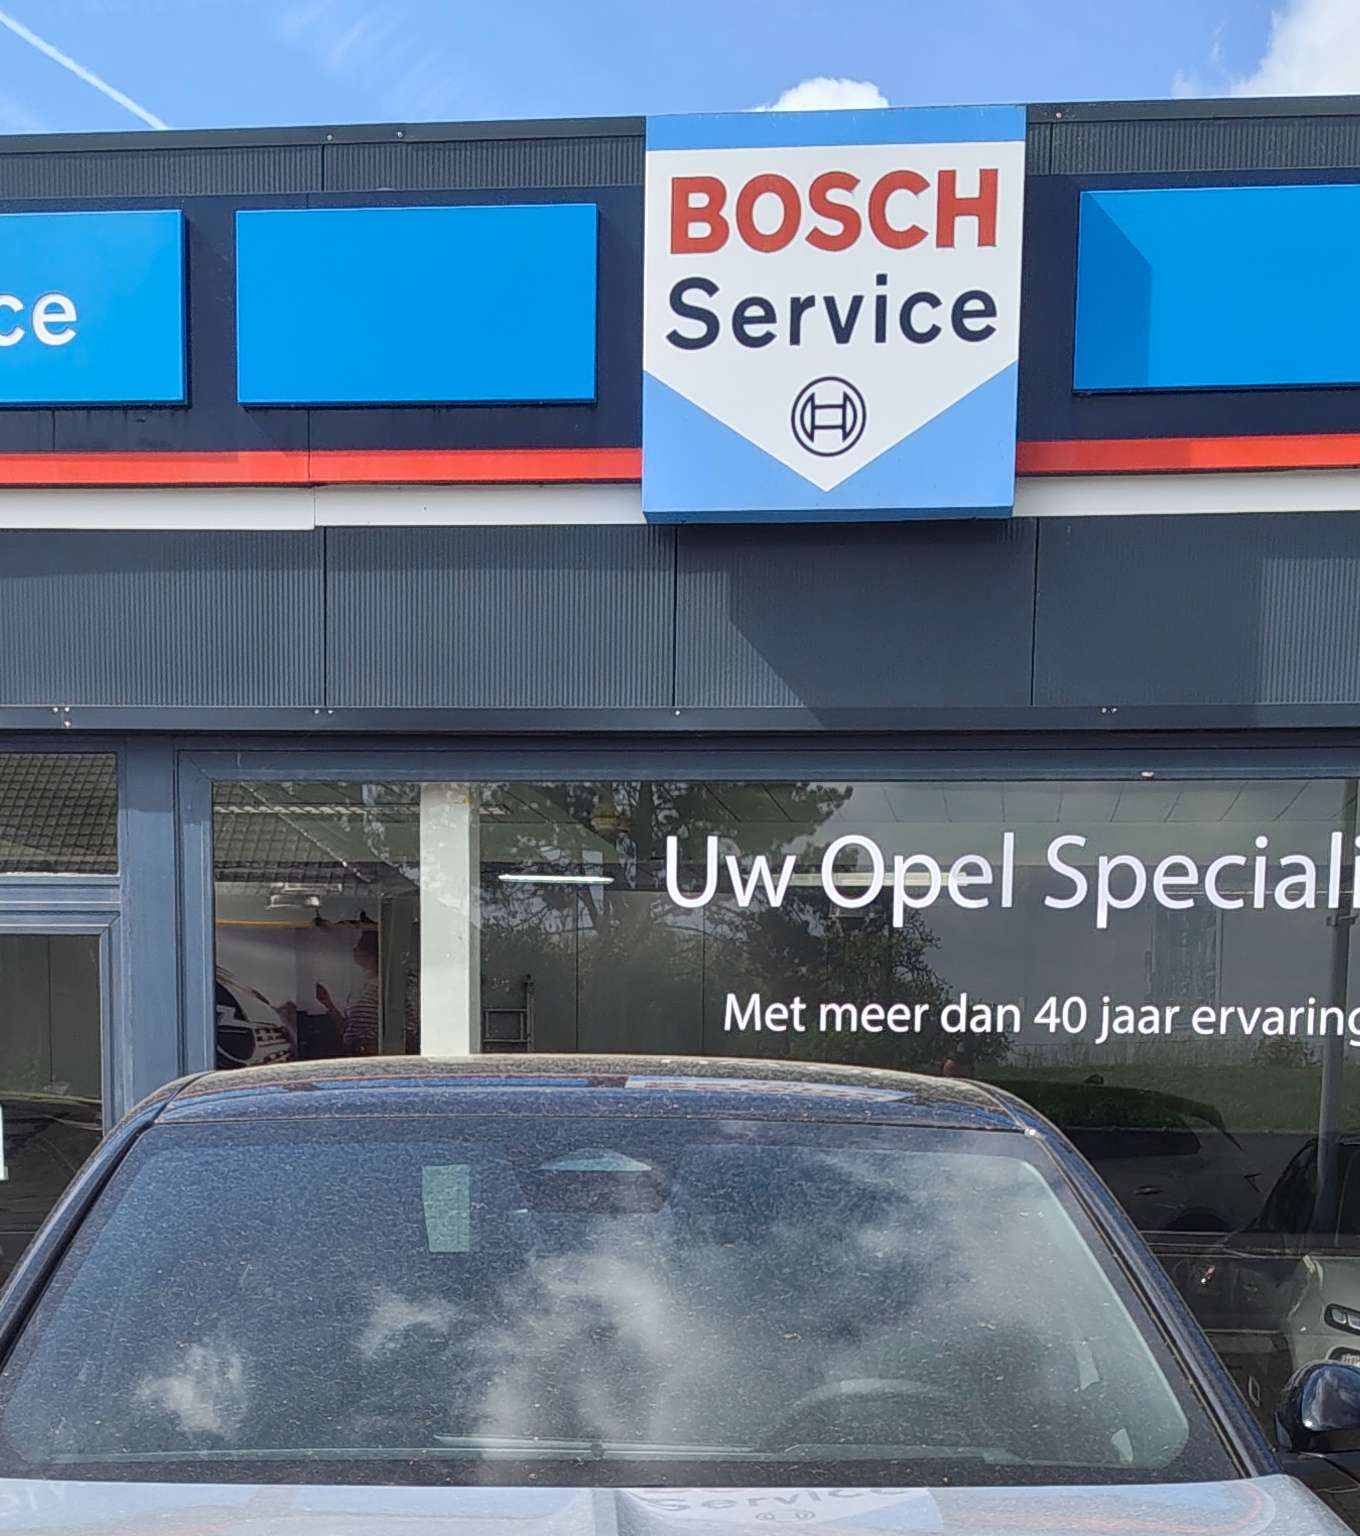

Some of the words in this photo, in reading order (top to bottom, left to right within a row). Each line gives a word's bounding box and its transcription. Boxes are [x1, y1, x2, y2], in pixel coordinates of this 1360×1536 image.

[670, 168, 1000, 256] BOSCH
[666, 273, 998, 351] Service
[666, 835, 798, 910] Uw
[821, 831, 1016, 928] Opel
[723, 993, 808, 1034] Met
[819, 1003, 931, 1034] meer
[940, 993, 1023, 1034] dan
[1033, 995, 1086, 1034] 40
[1092, 996, 1181, 1046] jaar
